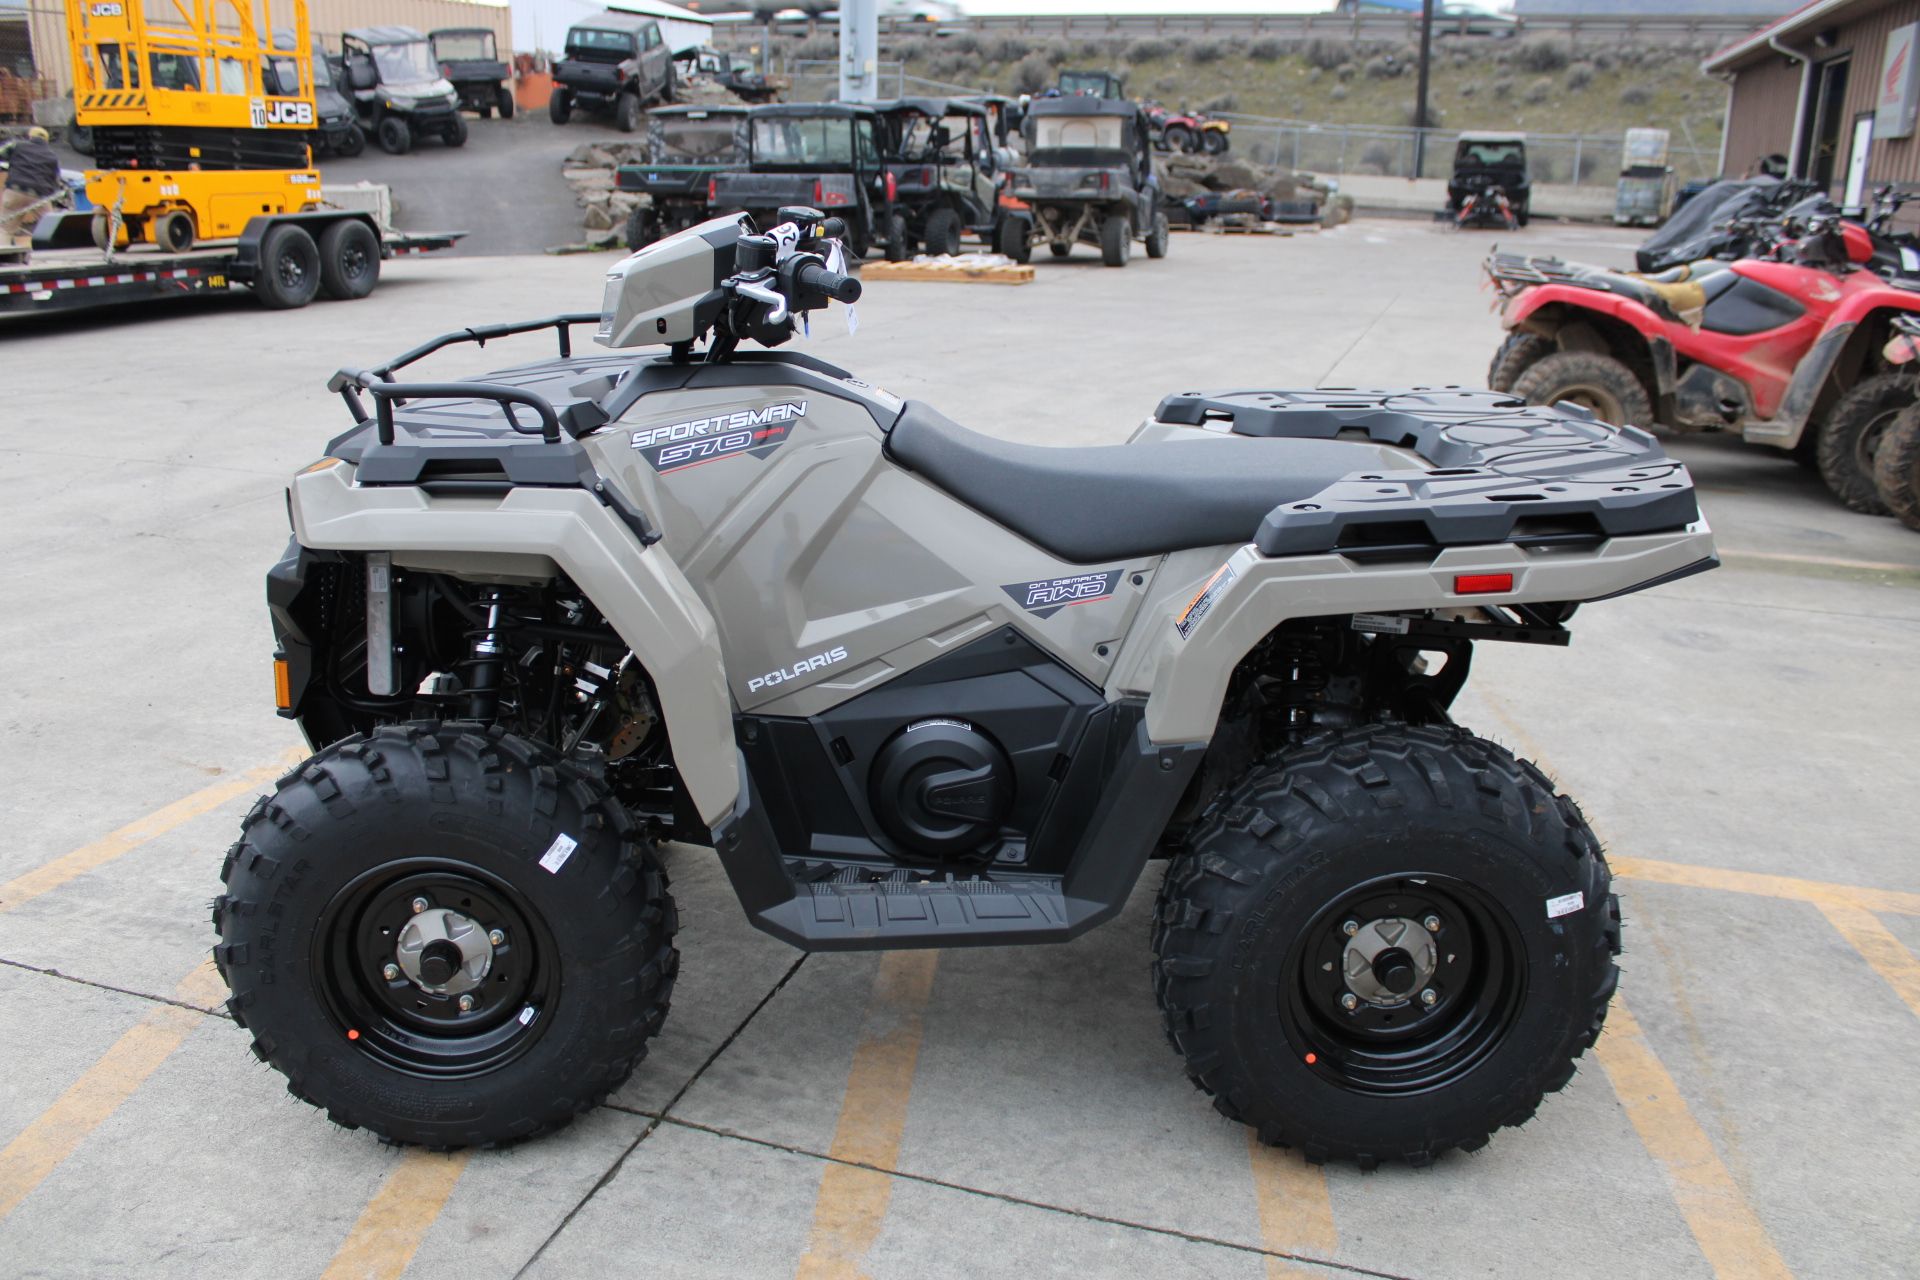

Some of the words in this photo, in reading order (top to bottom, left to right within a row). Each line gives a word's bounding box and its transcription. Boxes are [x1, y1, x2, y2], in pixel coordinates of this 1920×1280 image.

[92, 4, 122, 16] JCB
[267, 101, 313, 124] JCB
[631, 401, 807, 449] SPORTSMAN
[658, 430, 752, 465] 570
[1026, 580, 1106, 605] AWD
[1029, 582, 1047, 590] ON
[1053, 573, 1107, 586] DEMAND
[747, 645, 848, 693] POLARIS
